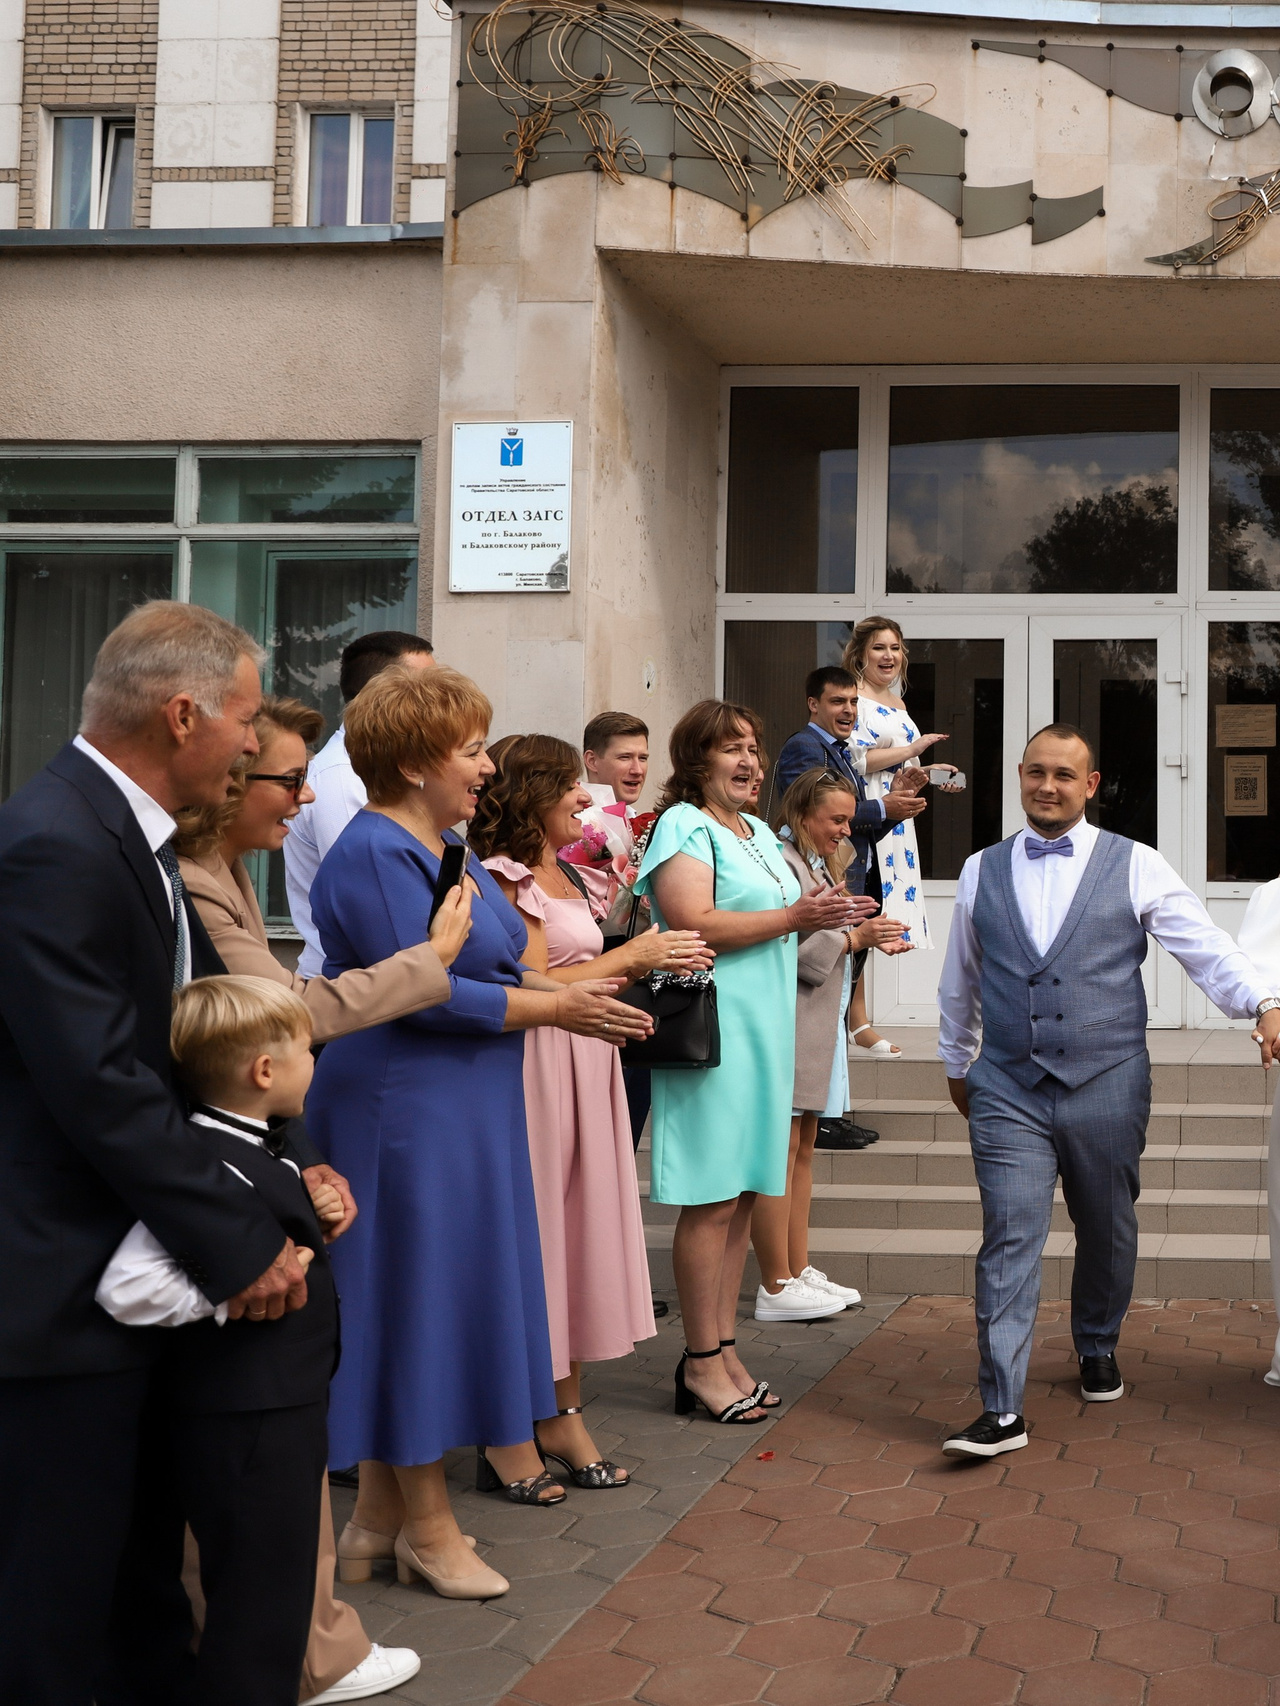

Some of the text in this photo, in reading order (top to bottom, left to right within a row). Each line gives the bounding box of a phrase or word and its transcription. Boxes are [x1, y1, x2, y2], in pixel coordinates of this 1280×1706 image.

[462, 510, 563, 523] ОТДЕЛ ЗАГС
[531, 542, 561, 550] району
